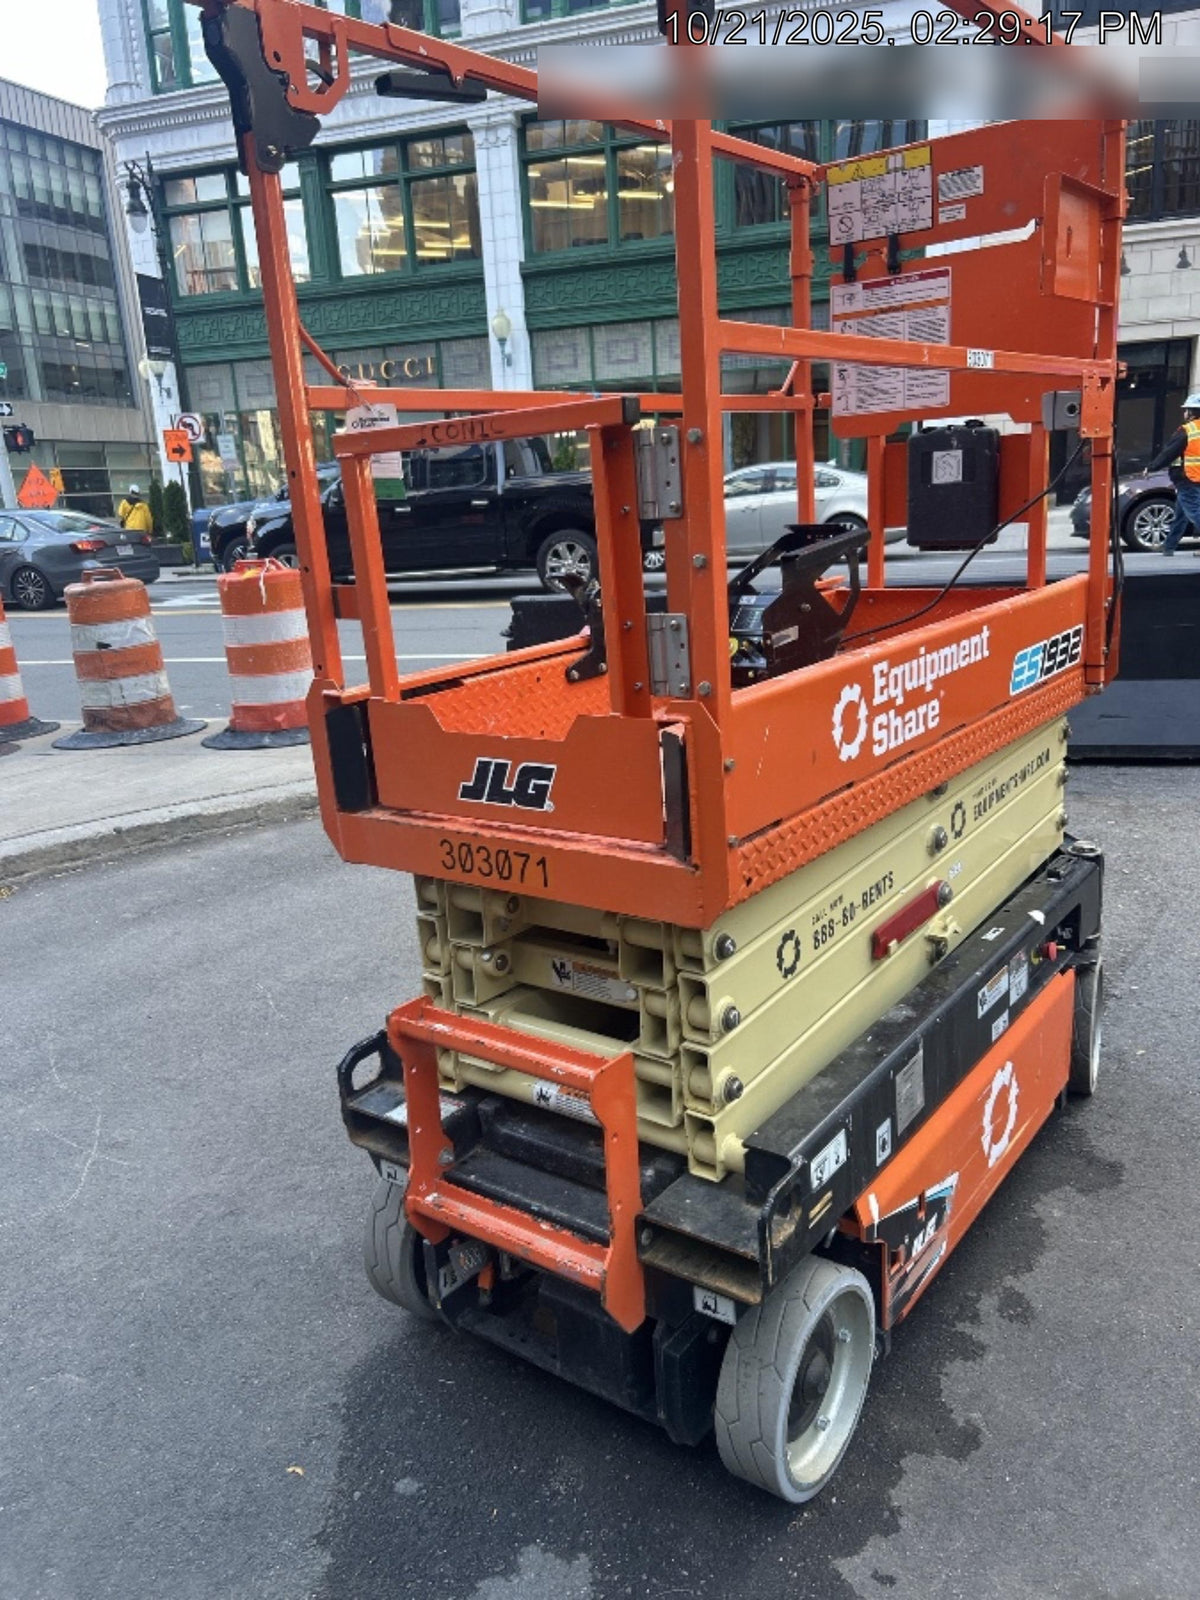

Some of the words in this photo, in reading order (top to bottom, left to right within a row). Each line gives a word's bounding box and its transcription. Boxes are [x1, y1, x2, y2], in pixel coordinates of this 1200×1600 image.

[337, 356, 434, 381] GUCCI
[873, 625, 990, 706] Equipment
[1010, 626, 1083, 694] ES1932
[873, 698, 940, 757] Share
[458, 757, 557, 812] JLG
[439, 838, 549, 888] 303071
